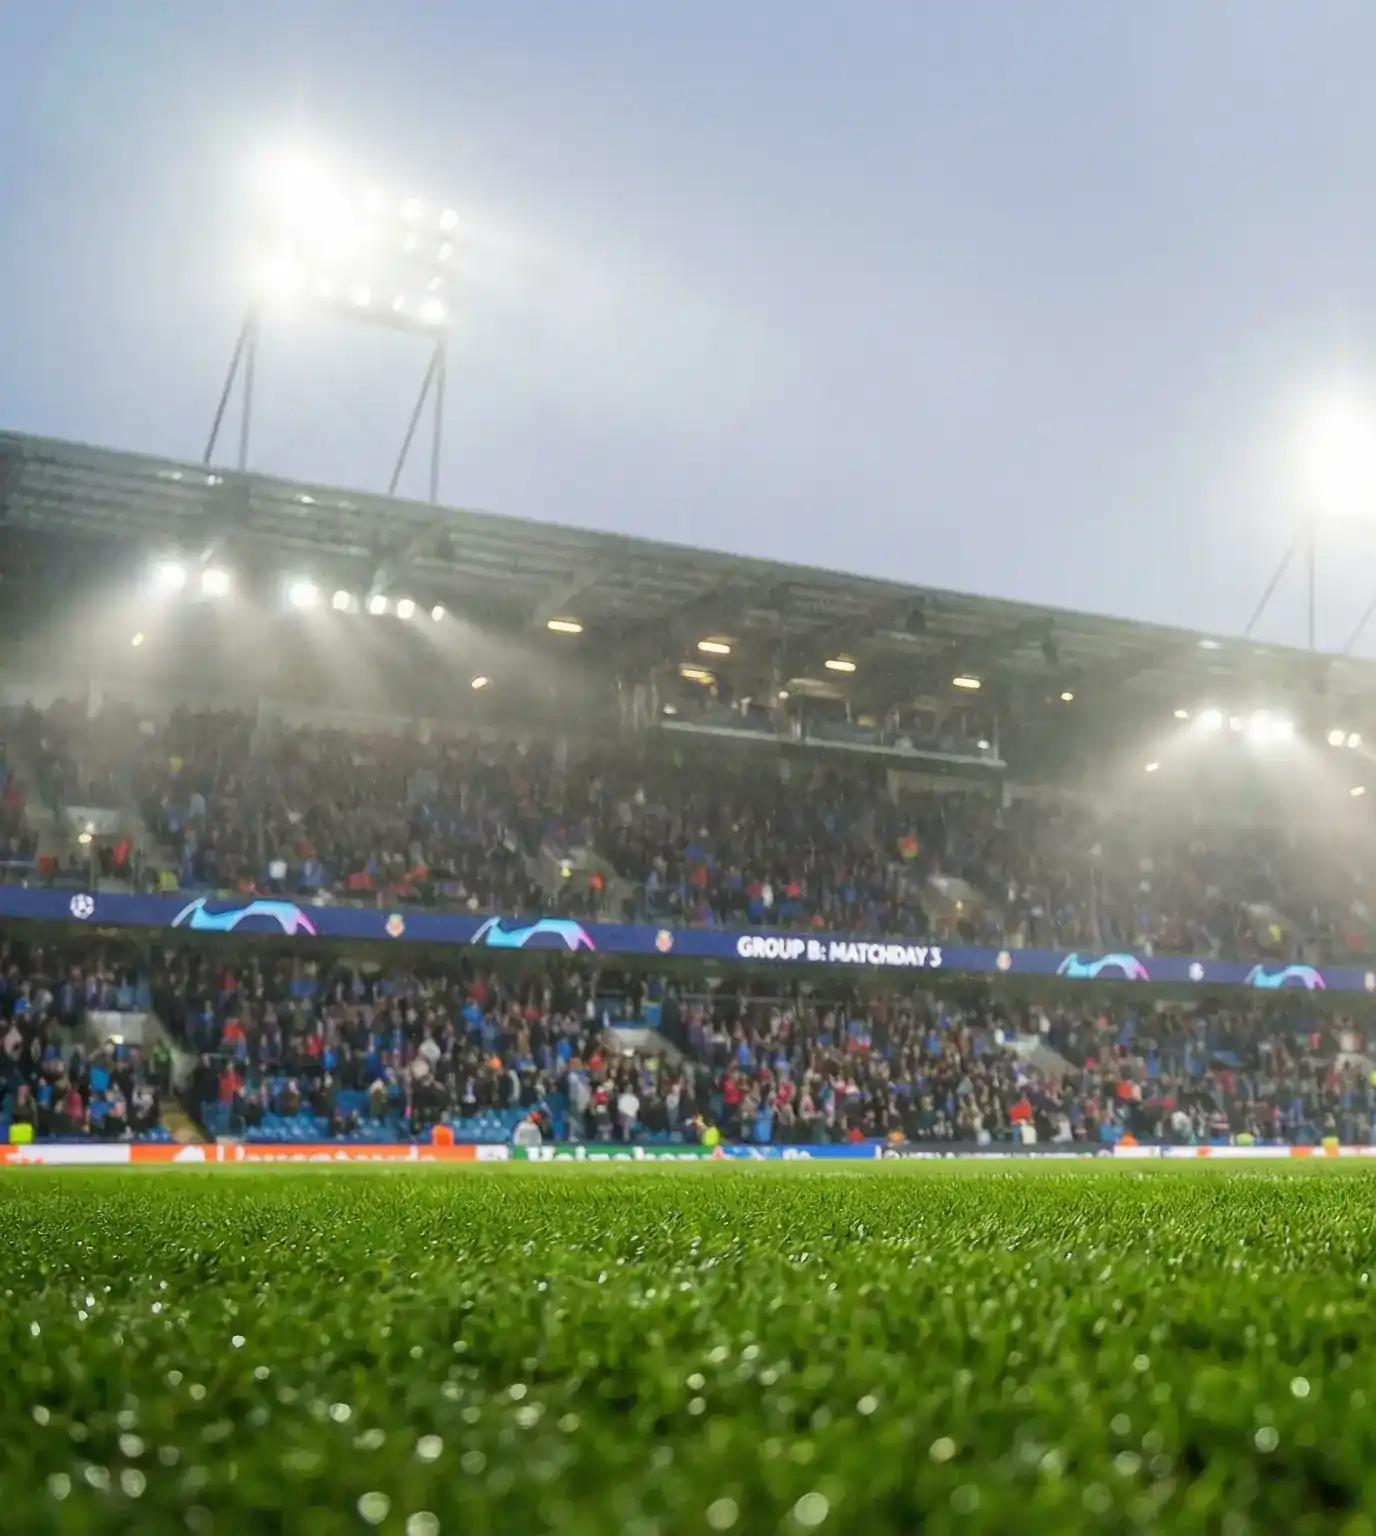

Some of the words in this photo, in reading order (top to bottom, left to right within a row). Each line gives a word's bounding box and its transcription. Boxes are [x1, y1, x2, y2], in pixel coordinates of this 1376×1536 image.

[737, 935, 805, 960] GROUP
[807, 940, 826, 962] B:
[829, 941, 928, 968] MATCHDAY
